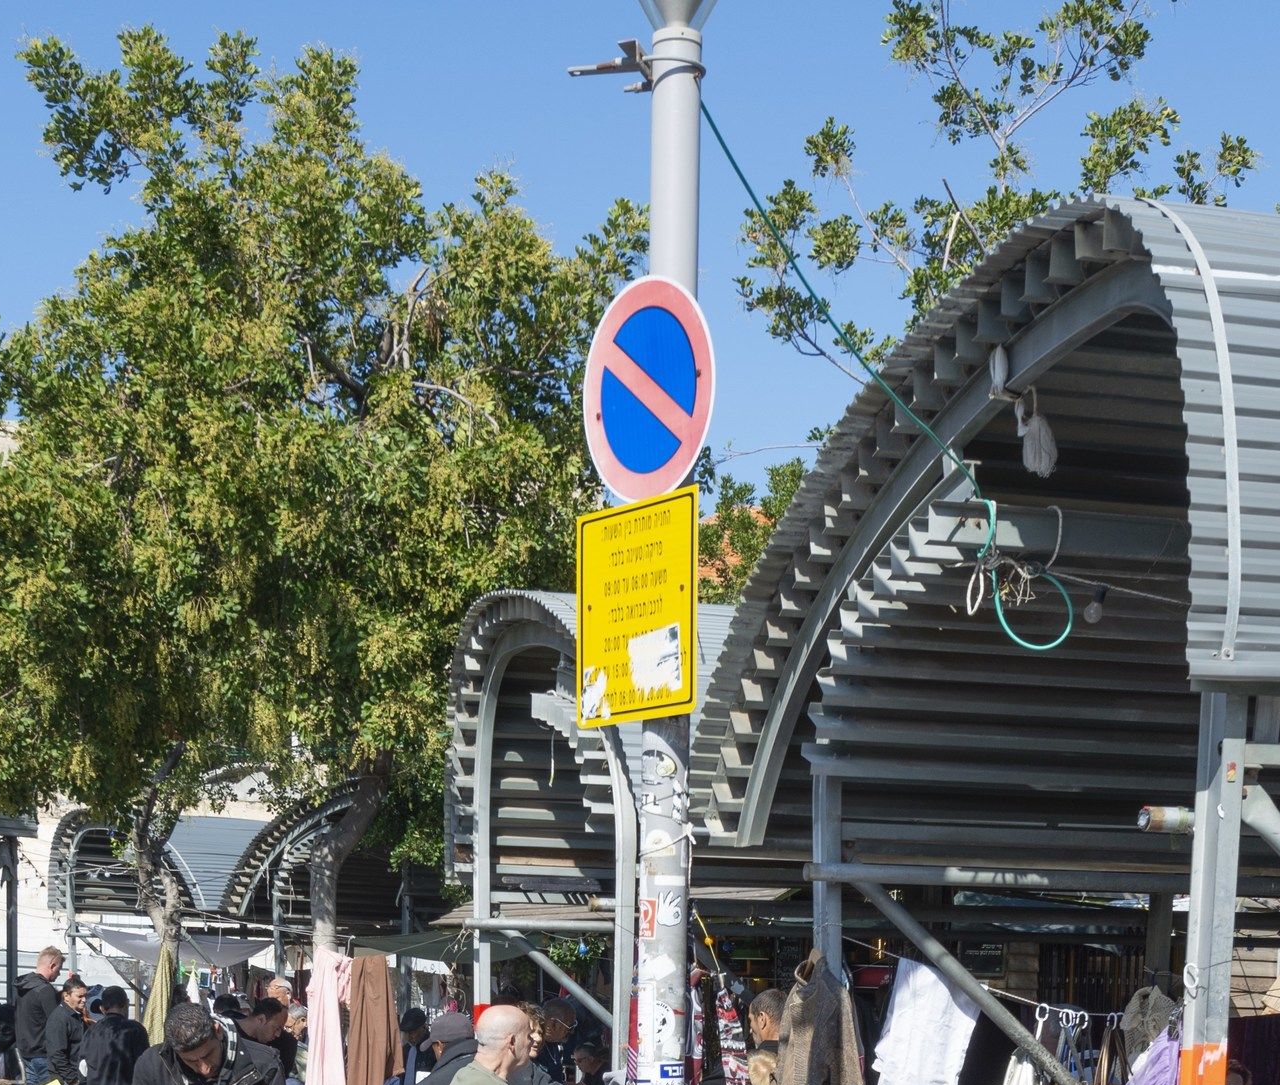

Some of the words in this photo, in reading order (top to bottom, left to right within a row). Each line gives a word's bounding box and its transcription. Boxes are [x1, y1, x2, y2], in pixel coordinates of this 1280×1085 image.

[634, 514, 652, 531] מותרת
[654, 510, 671, 527] החניה
[624, 520, 632, 539] בין
[622, 578, 630, 594] עד
[632, 573, 648, 591] 06:00
[650, 568, 668, 588] משעה
[604, 580, 620, 597] 09:00
[604, 636, 620, 652] 20:00
[612, 662, 628, 678] 15:00
[620, 690, 636, 706] 06:00
